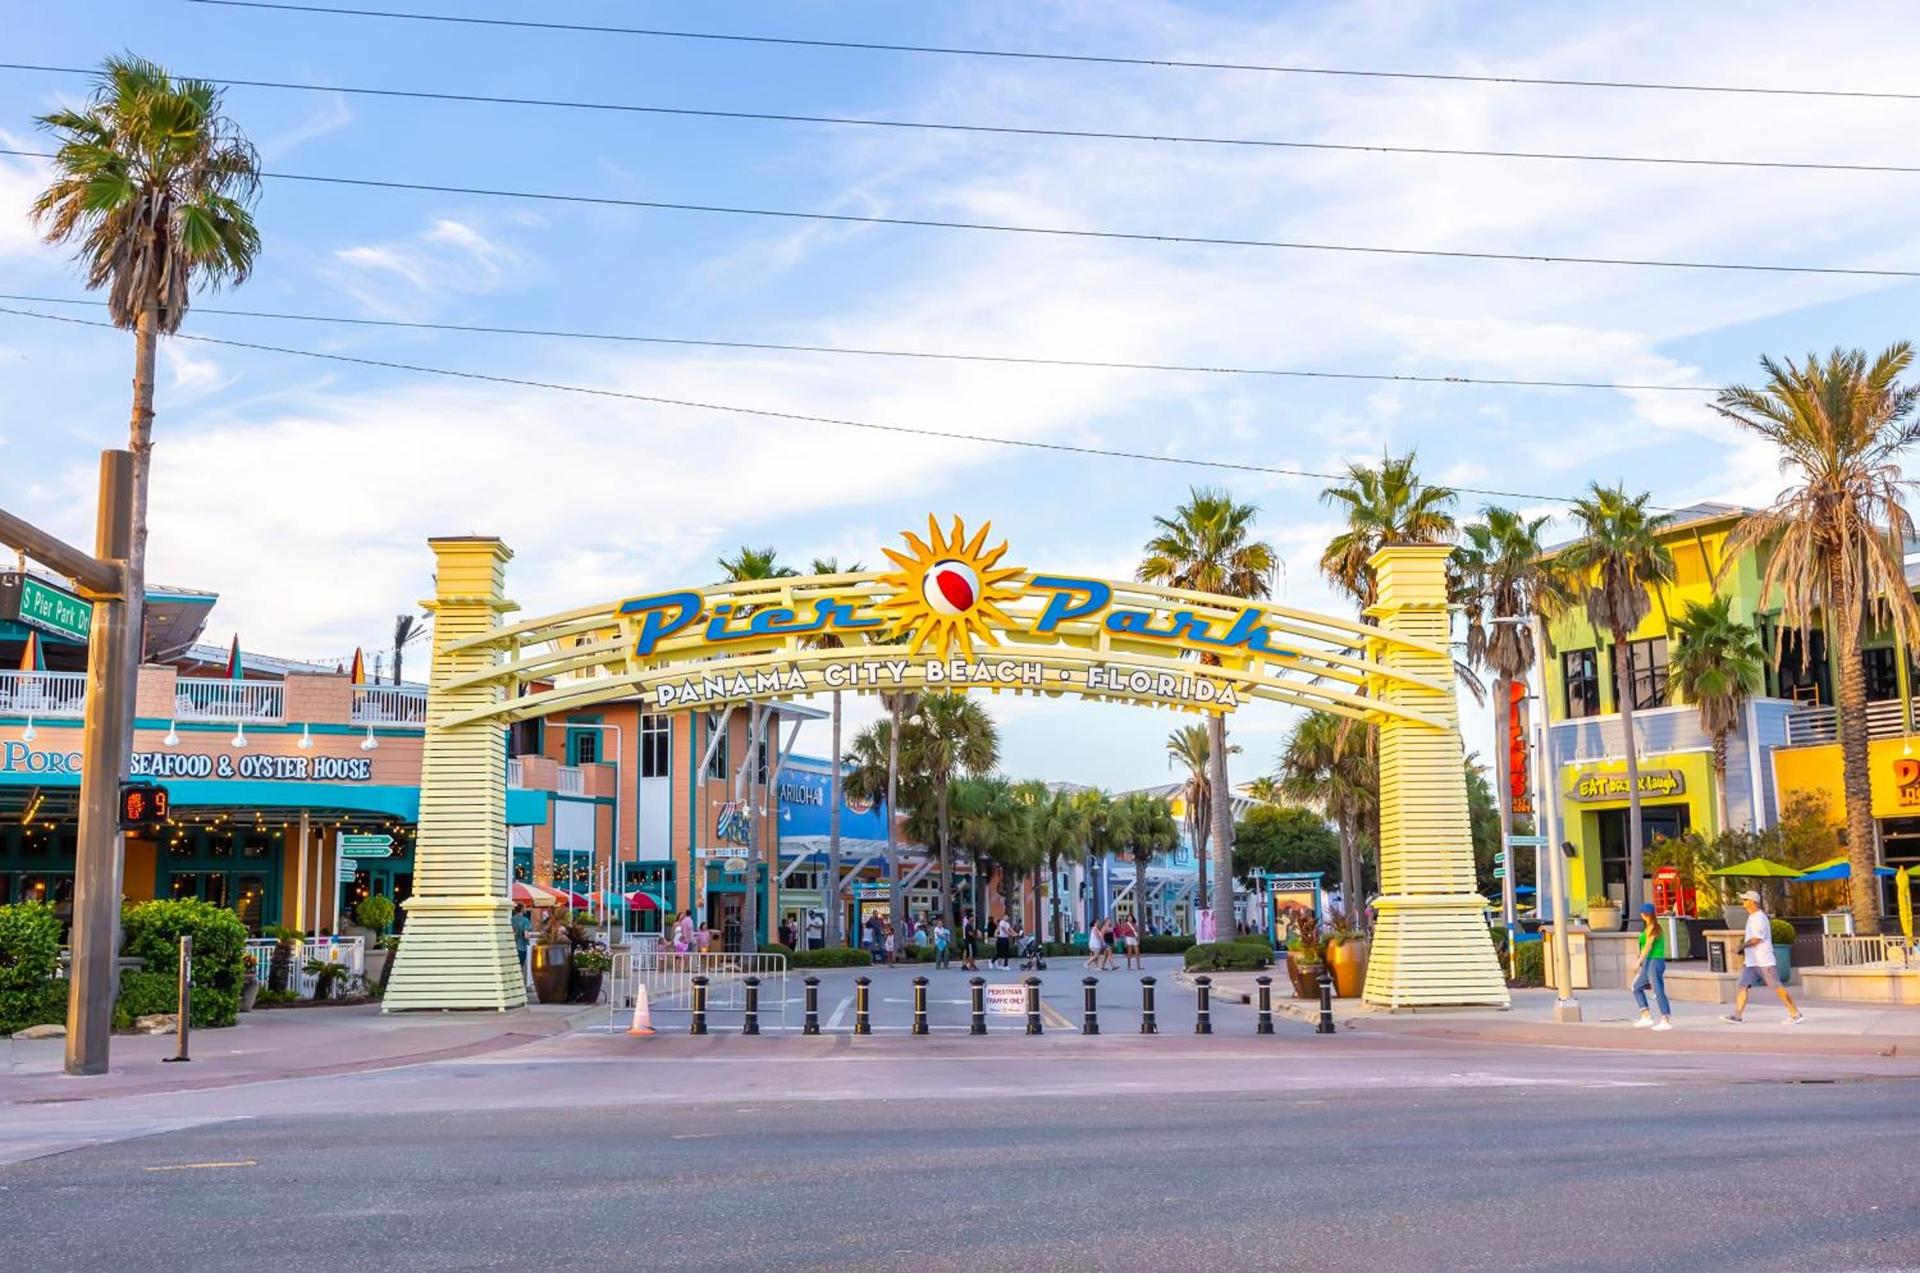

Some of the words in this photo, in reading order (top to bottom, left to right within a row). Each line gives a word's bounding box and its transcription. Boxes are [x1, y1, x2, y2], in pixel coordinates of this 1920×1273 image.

[23, 587, 31, 609] S
[33, 591, 53, 618] Pier
[56, 600, 75, 626] Park
[78, 608, 89, 631] Dr
[616, 590, 886, 658] Pier
[1027, 574, 1299, 659] Park
[656, 666, 808, 707] PANAMA
[822, 660, 908, 687] CITY
[925, 659, 1044, 685] BEACH
[1086, 667, 1240, 707] FLORIDA
[2, 741, 83, 773] PORC
[130, 752, 212, 778] SEAFOOD
[216, 754, 235, 778] &
[239, 755, 308, 779] OYSTER
[311, 757, 371, 781] HOUSE
[1580, 778, 1609, 797] EAT
[1646, 772, 1679, 795] laugh
[155, 791, 166, 816] 9
[1010, 997, 1025, 1005] ONLY
